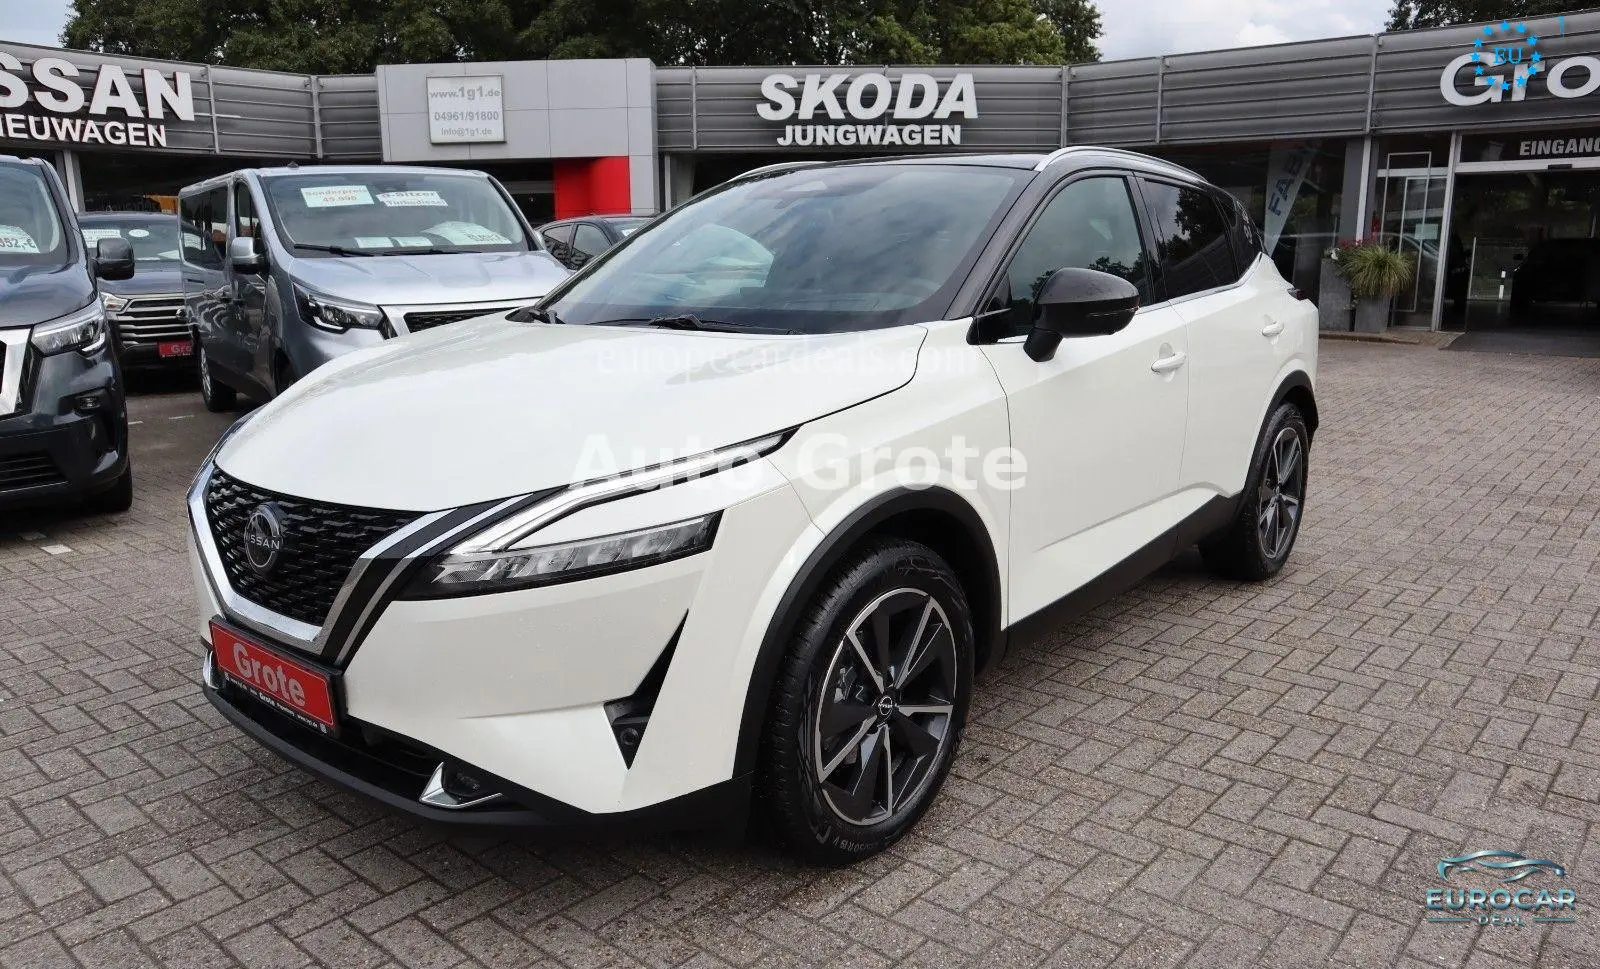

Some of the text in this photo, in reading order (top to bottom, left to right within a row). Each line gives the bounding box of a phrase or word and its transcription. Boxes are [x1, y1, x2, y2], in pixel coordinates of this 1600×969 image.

[430, 86, 501, 101] www.1g1.de
[756, 73, 979, 121] SKODA
[0, 113, 167, 148] EUWAGEN
[777, 124, 962, 147] JUNGWAGEN
[233, 642, 306, 707] Grote
